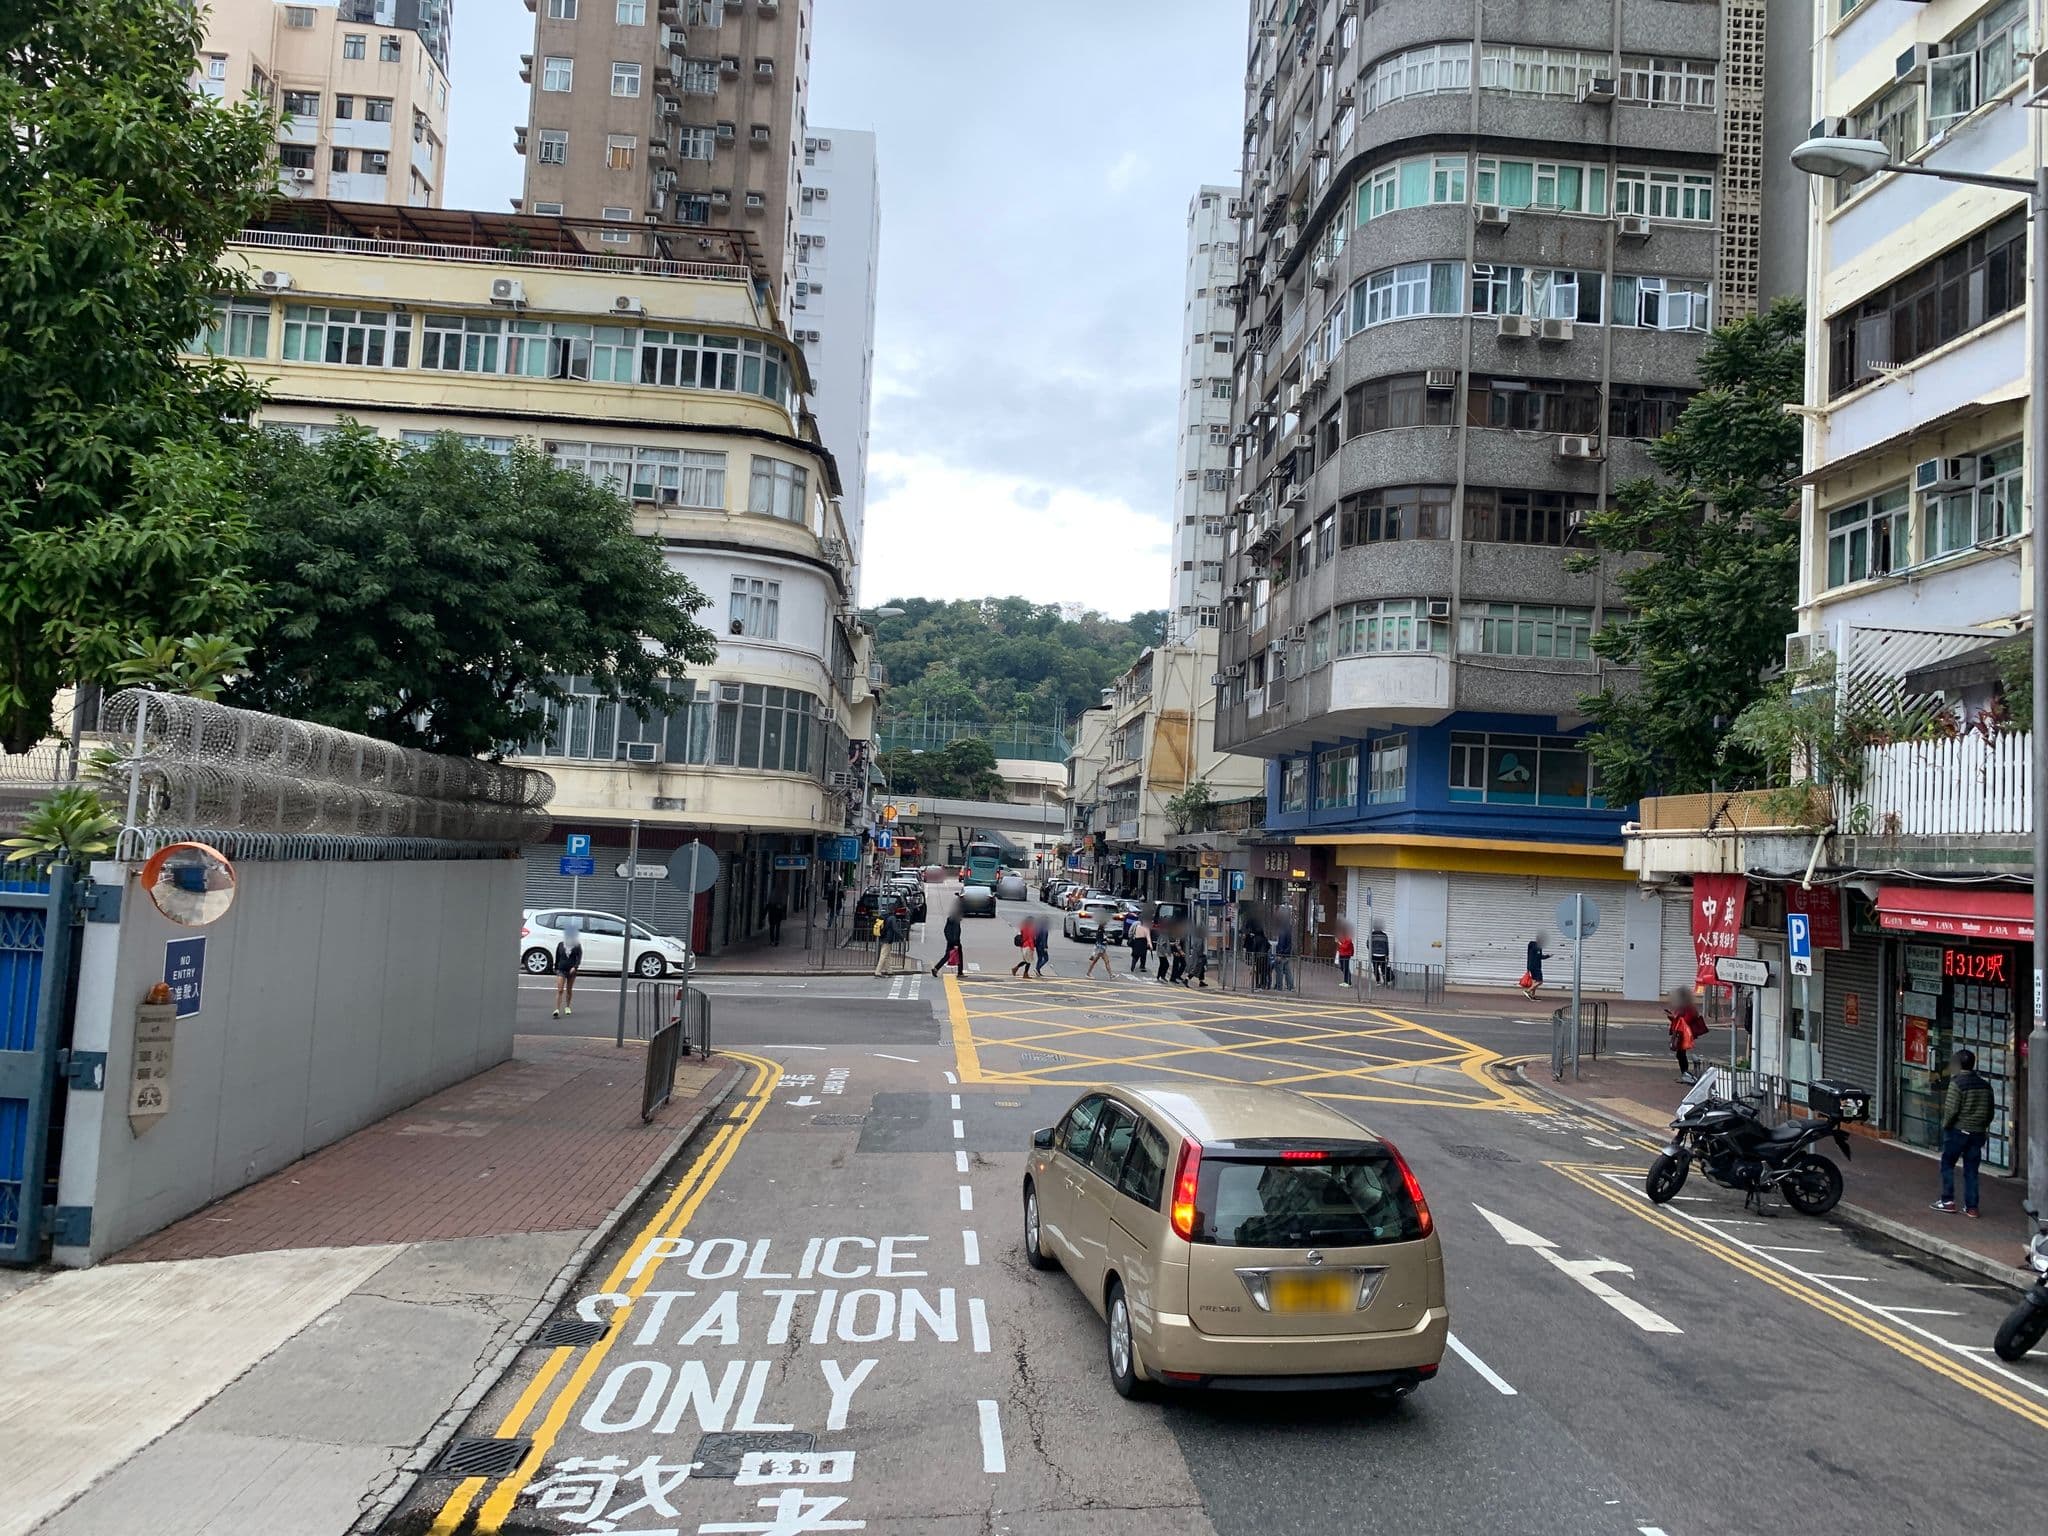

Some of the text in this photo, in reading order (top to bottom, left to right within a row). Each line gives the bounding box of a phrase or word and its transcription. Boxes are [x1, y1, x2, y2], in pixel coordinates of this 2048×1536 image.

[572, 836, 586, 854] P
[1702, 895, 1736, 927] 中英
[1791, 918, 1806, 953] P
[1988, 925, 2009, 936] LAVA
[172, 967, 196, 981] ENTRY
[180, 955, 191, 966] NO
[625, 1235, 930, 1280] POLICE
[576, 1287, 958, 1346] STATION
[579, 1358, 879, 1435] ONLY
